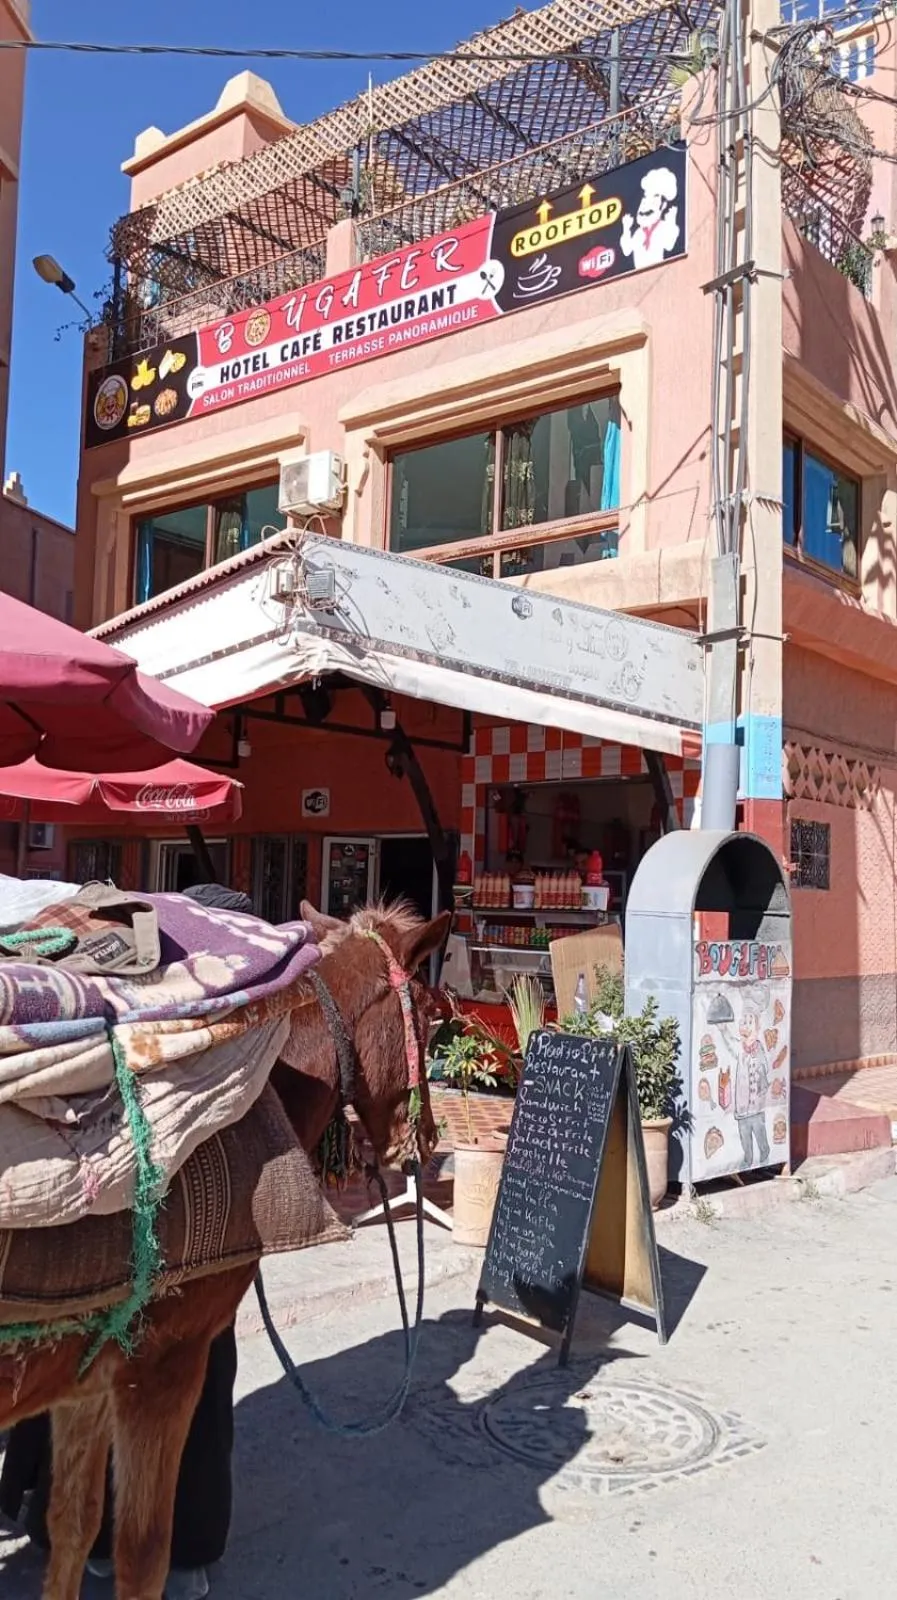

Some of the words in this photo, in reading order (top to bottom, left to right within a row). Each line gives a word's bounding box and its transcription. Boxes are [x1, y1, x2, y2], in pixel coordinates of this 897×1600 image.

[515, 203, 617, 252] ROOFTOP
[280, 328, 322, 363] CAFÉ
[332, 284, 457, 345] RESTAURANT
[328, 336, 385, 365] TERRASSE
[388, 305, 479, 345] PANORAMIQUE
[203, 388, 235, 407] SALON
[238, 363, 311, 395] TRADITIONNEL
[534, 1075, 585, 1100] SNACK
